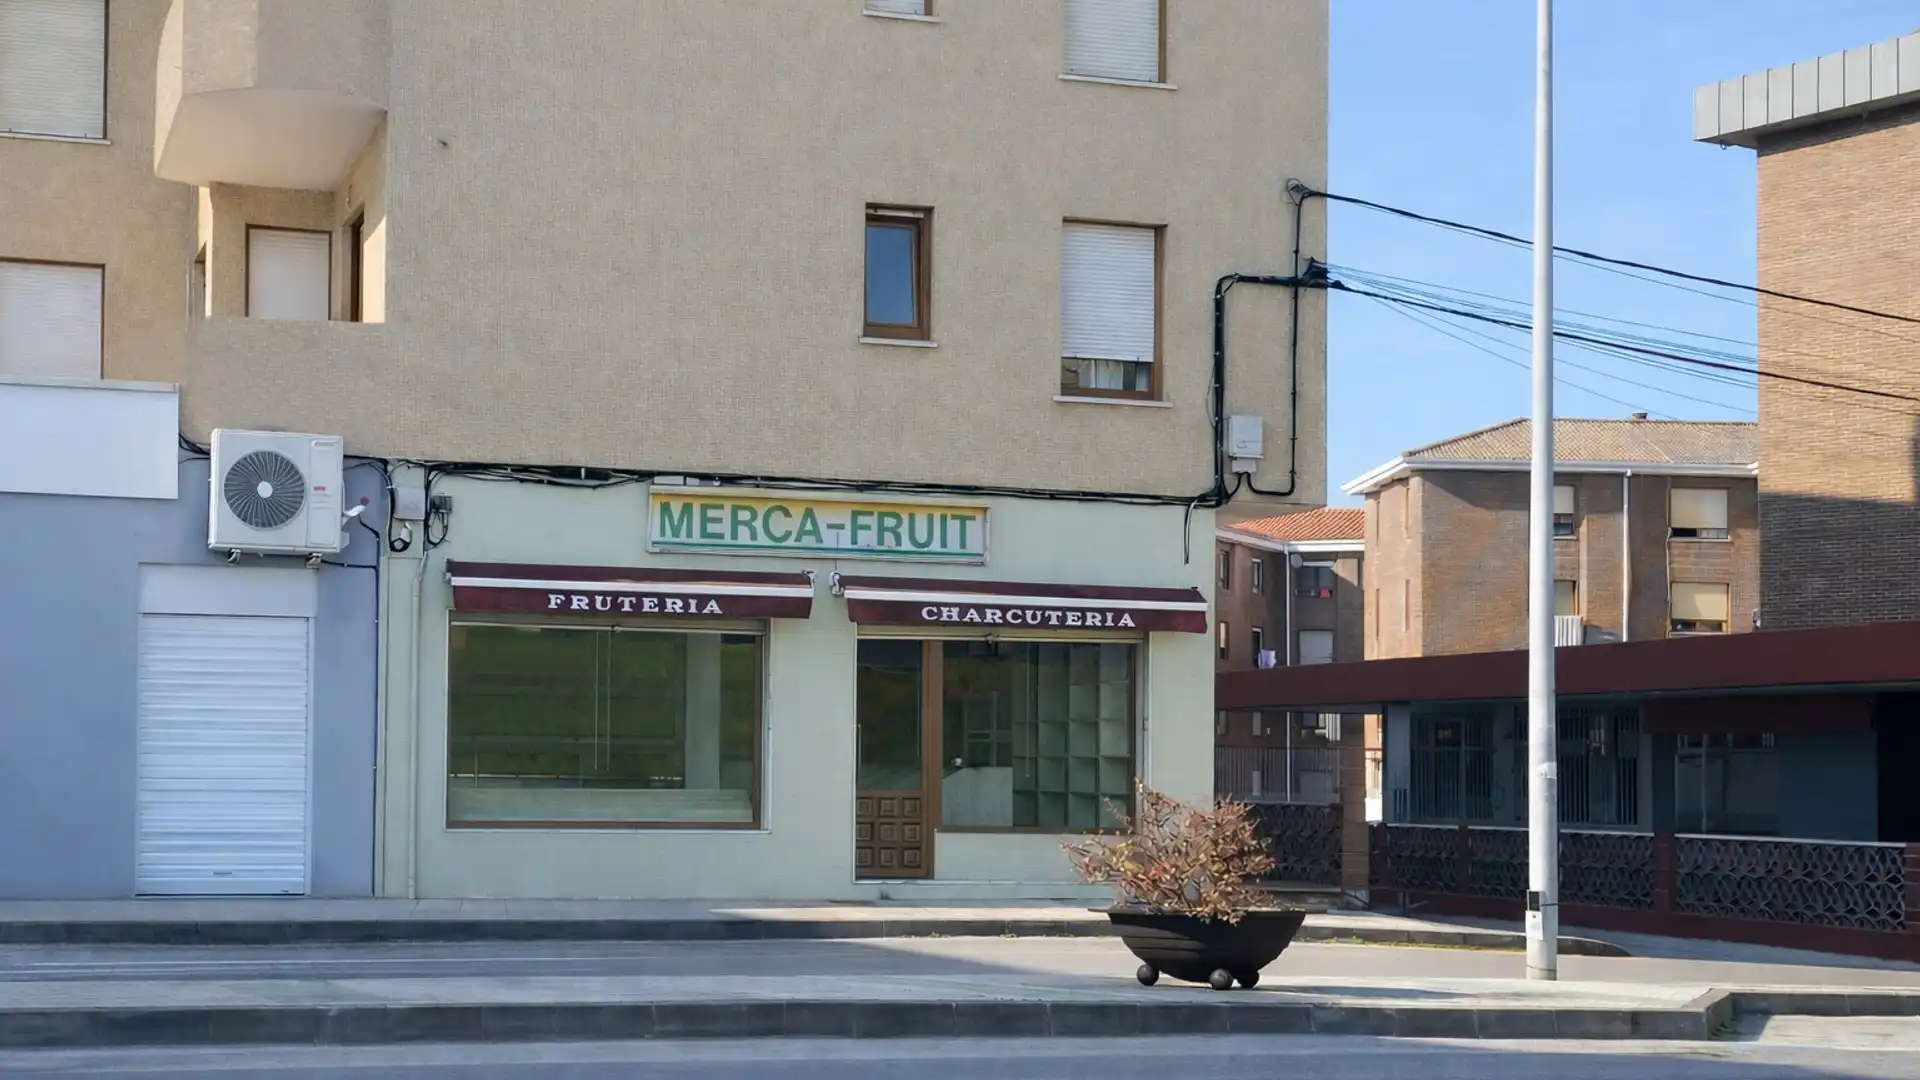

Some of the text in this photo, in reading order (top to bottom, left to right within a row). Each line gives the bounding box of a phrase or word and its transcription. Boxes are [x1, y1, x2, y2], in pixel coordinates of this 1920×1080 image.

[659, 501, 976, 550] MERCA-FRUIT
[547, 593, 723, 614] FRUTERIA
[921, 606, 1136, 627] CHARCUTERIA
